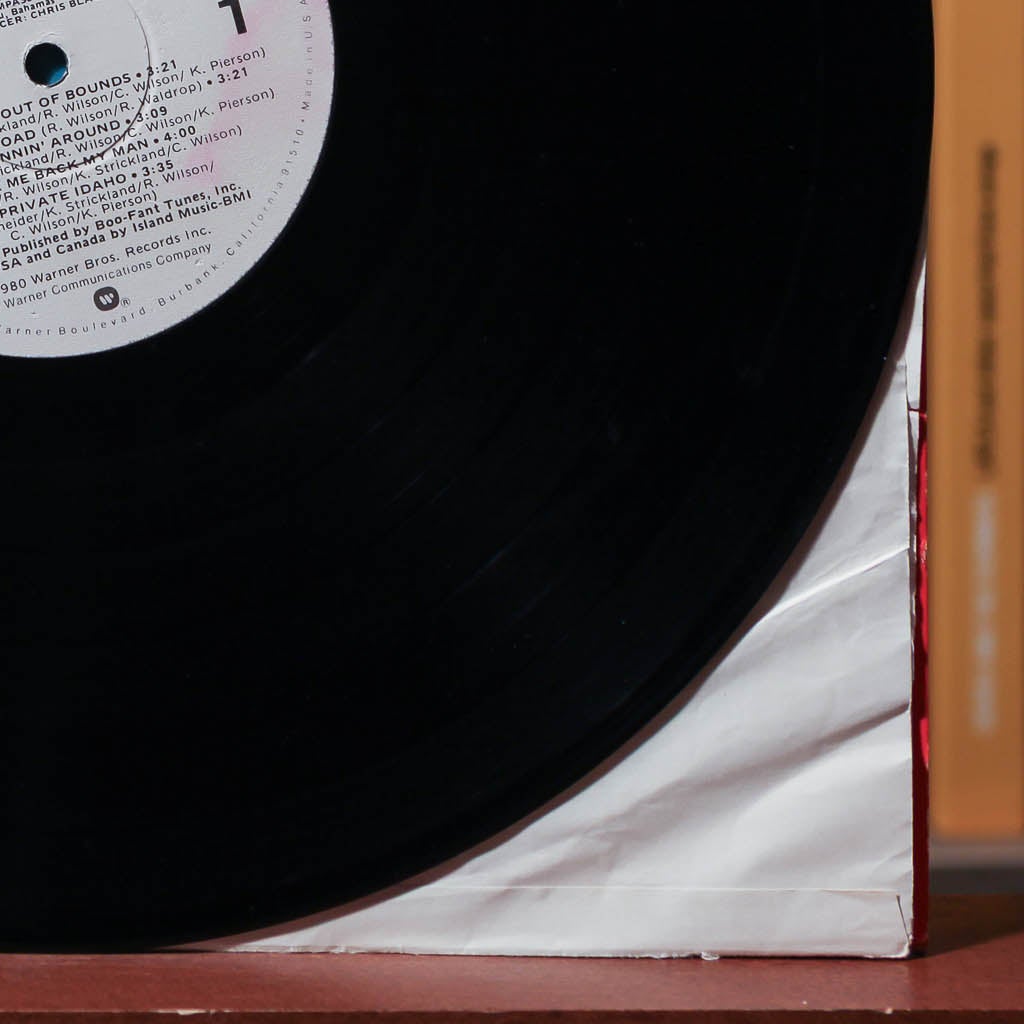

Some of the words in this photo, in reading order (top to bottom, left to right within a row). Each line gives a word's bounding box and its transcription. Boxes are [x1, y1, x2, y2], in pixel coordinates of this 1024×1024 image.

[29, 1, 66, 19] CHRIS
[209, 46, 265, 73] Pierson)
[0, 100, 32, 119] OUT
[38, 92, 63, 109] OF
[64, 72, 133, 102] BOUNDS
[145, 59, 176, 78] 3:21
[38, 121, 64, 138] (R.
[137, 80, 202, 110] Waldrop)
[216, 66, 247, 83] 3:21
[217, 87, 274, 111] Pierson)
[48, 118, 122, 149] AROUND
[133, 105, 167, 124] 3:09
[189, 124, 241, 147] Wilson)
[4, 171, 32, 189] ME
[32, 158, 79, 182] BACK
[80, 148, 108, 166] MY
[110, 138, 149, 159] MAN
[161, 124, 196, 145] 4:00
[73, 172, 129, 197] IDAHO
[140, 159, 173, 178] 3:35
[0, 228, 71, 259] Published
[70, 222, 92, 240] by
[92, 203, 162, 233] Boo-Fant
[162, 191, 212, 213] Tunes,
[214, 182, 242, 197] Inc.
[10, 227, 25, 242] C.
[98, 188, 157, 217] Pierson)
[24, 245, 52, 264] and
[52, 229, 108, 255] Canada
[107, 223, 128, 239] by
[130, 210, 173, 232] Island
[175, 188, 251, 219] Music-BMI
[2, 287, 49, 308] Warner
[155, 240, 211, 265] Company
[29, 263, 82, 287] Warner
[83, 253, 119, 272] Bros.
[124, 231, 183, 258] Records
[184, 226, 211, 240] Inc.
